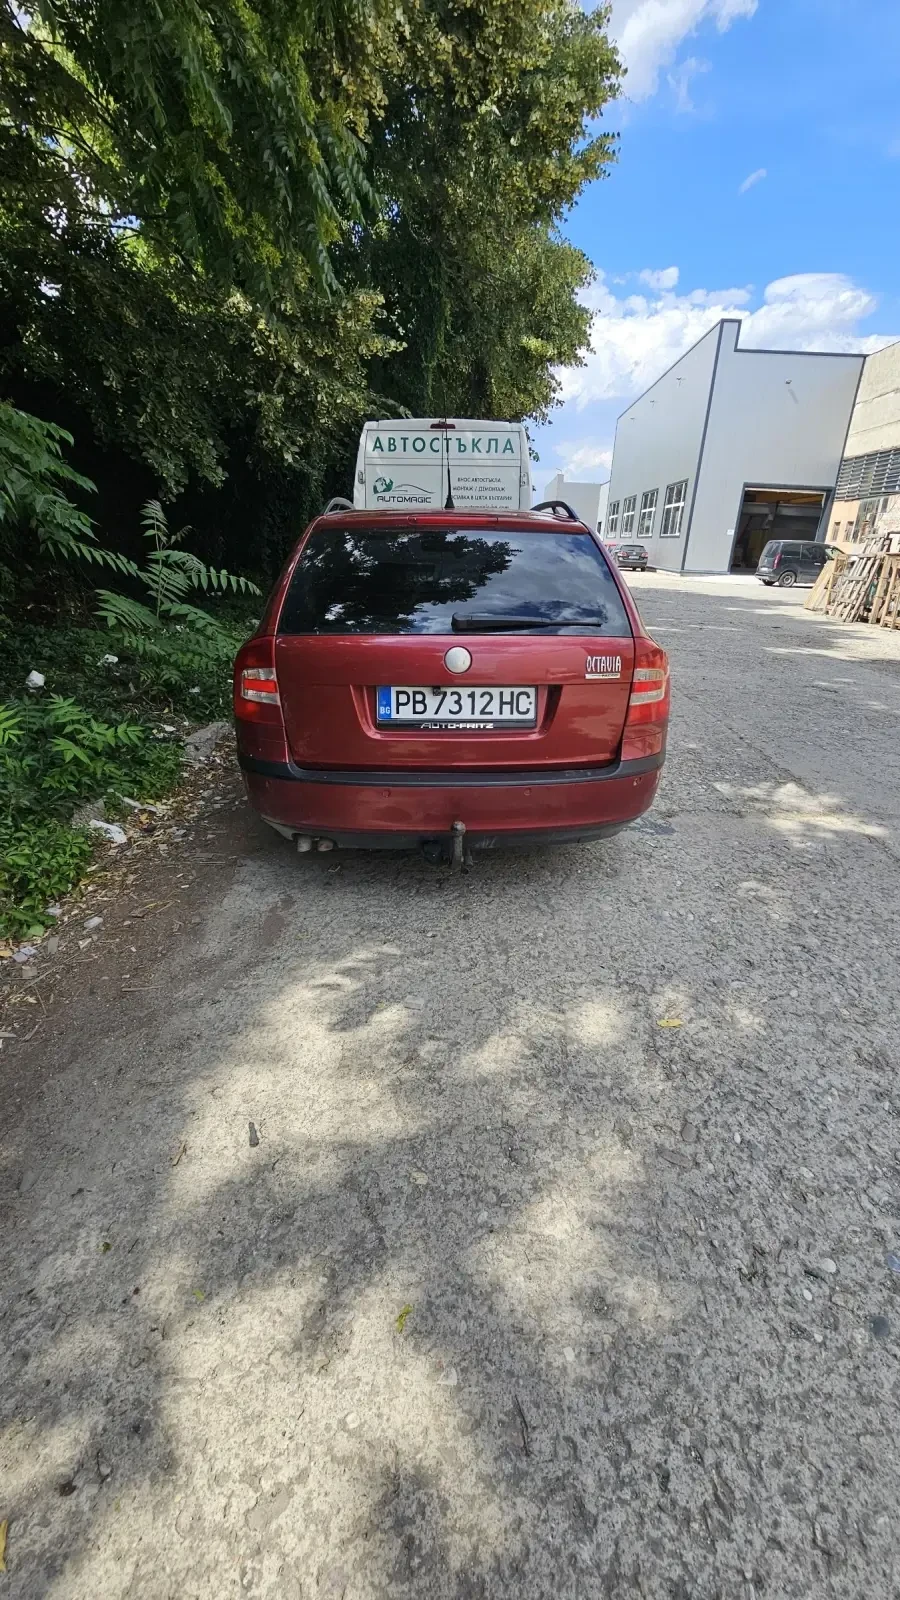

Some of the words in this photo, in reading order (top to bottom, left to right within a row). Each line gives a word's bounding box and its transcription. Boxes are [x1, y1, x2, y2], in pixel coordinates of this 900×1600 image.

[372, 436, 515, 454] АВТОСТЪКЛА
[376, 495, 432, 503] AUTOMAGIC
[586, 656, 622, 672] OCTAVIA
[380, 706, 391, 714] BG
